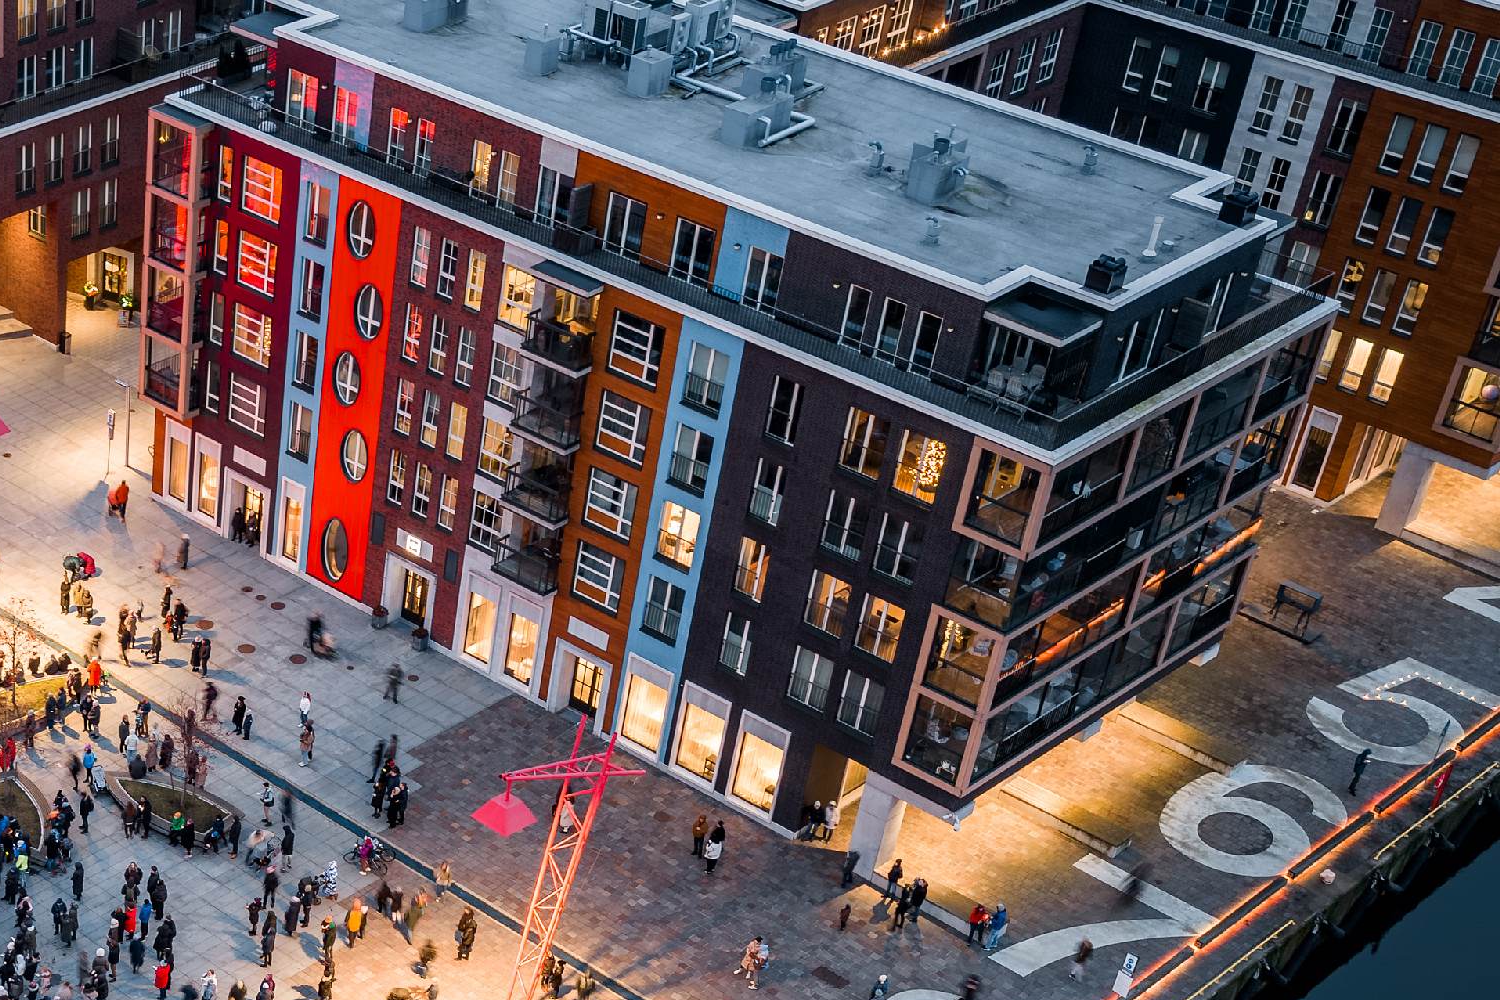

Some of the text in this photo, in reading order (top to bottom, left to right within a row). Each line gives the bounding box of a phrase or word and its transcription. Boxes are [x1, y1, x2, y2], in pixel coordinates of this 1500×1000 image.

[1306, 657, 1500, 765] 5
[1158, 760, 1348, 877] 6
[988, 853, 1220, 977] 7
